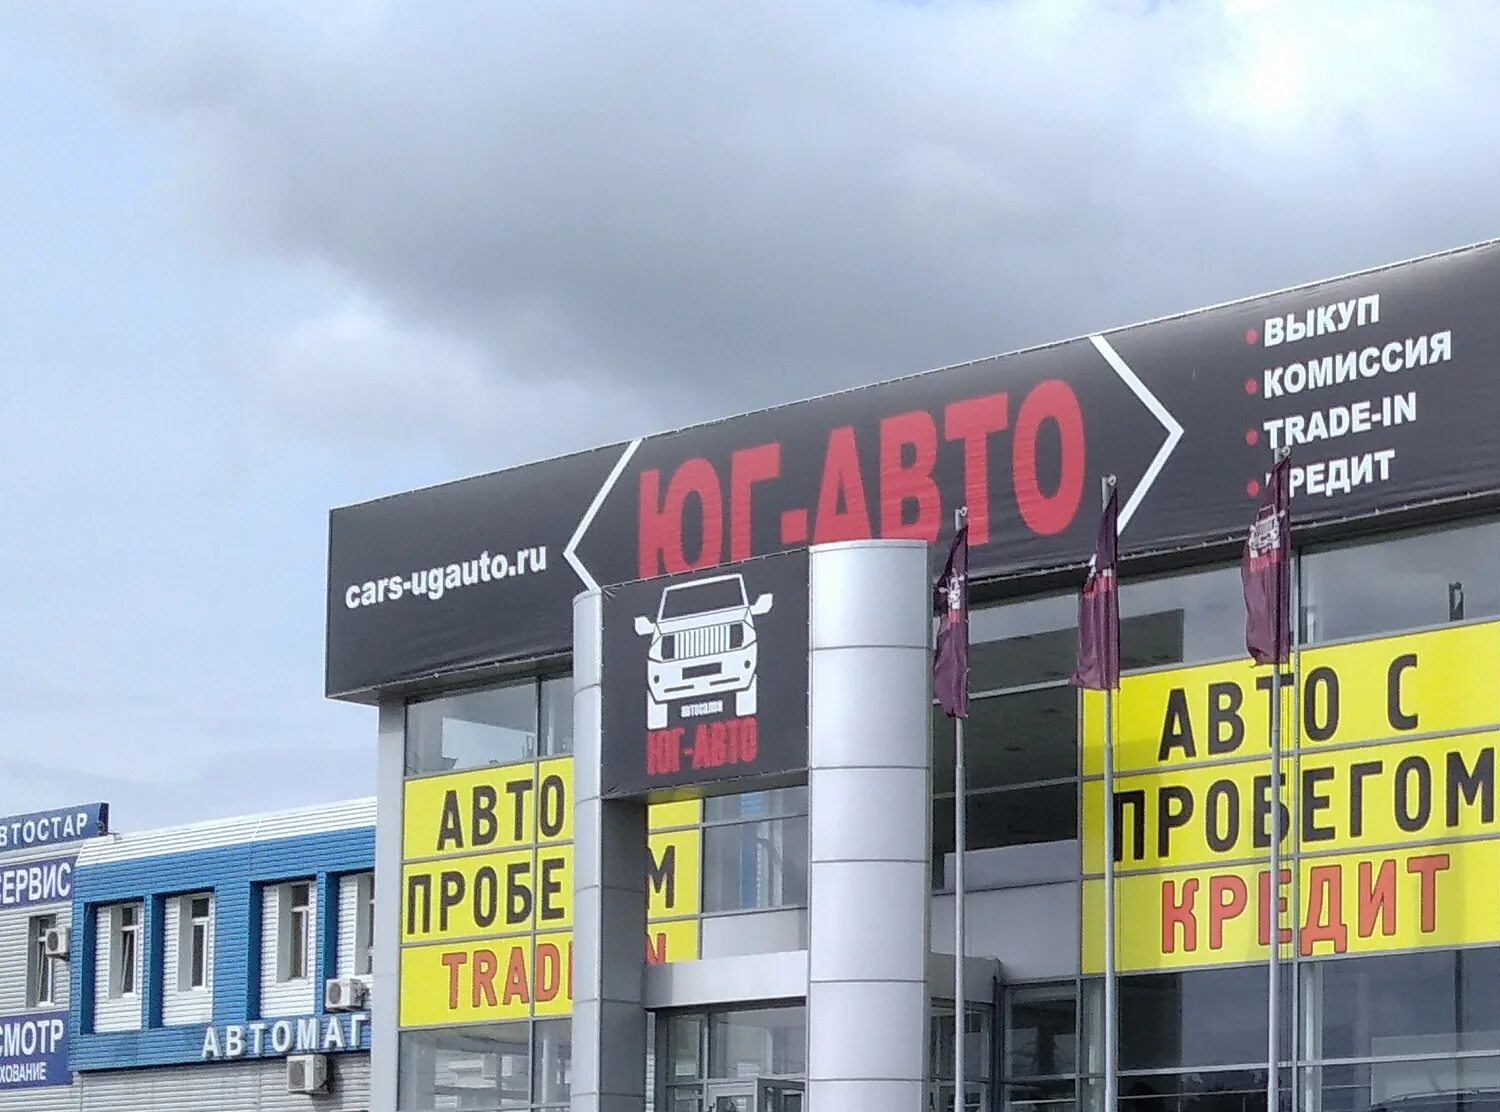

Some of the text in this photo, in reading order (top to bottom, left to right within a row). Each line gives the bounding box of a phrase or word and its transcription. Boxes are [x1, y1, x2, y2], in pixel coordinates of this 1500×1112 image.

[1263, 294, 1381, 348] ВЫКУП
[1263, 330, 1453, 399] КОМИССИЯ
[1263, 391, 1418, 450] TRADE-IN
[638, 378, 1087, 580] ЮГ-АВТО
[1265, 448, 1396, 498] РЕДИТ
[344, 545, 548, 612] cars-ugauto.ru
[1157, 653, 1419, 762] АВТО С
[437, 774, 566, 851] АВТО
[1111, 746, 1496, 862] ПРОБЕГОМ
[0, 861, 71, 905] ЕРВИС
[406, 844, 675, 935] ПРОБЕМ
[1161, 853, 1451, 957] КРЕДИТ
[0, 1019, 64, 1057] МОТР
[201, 1014, 369, 1059] АВТОМАГ
